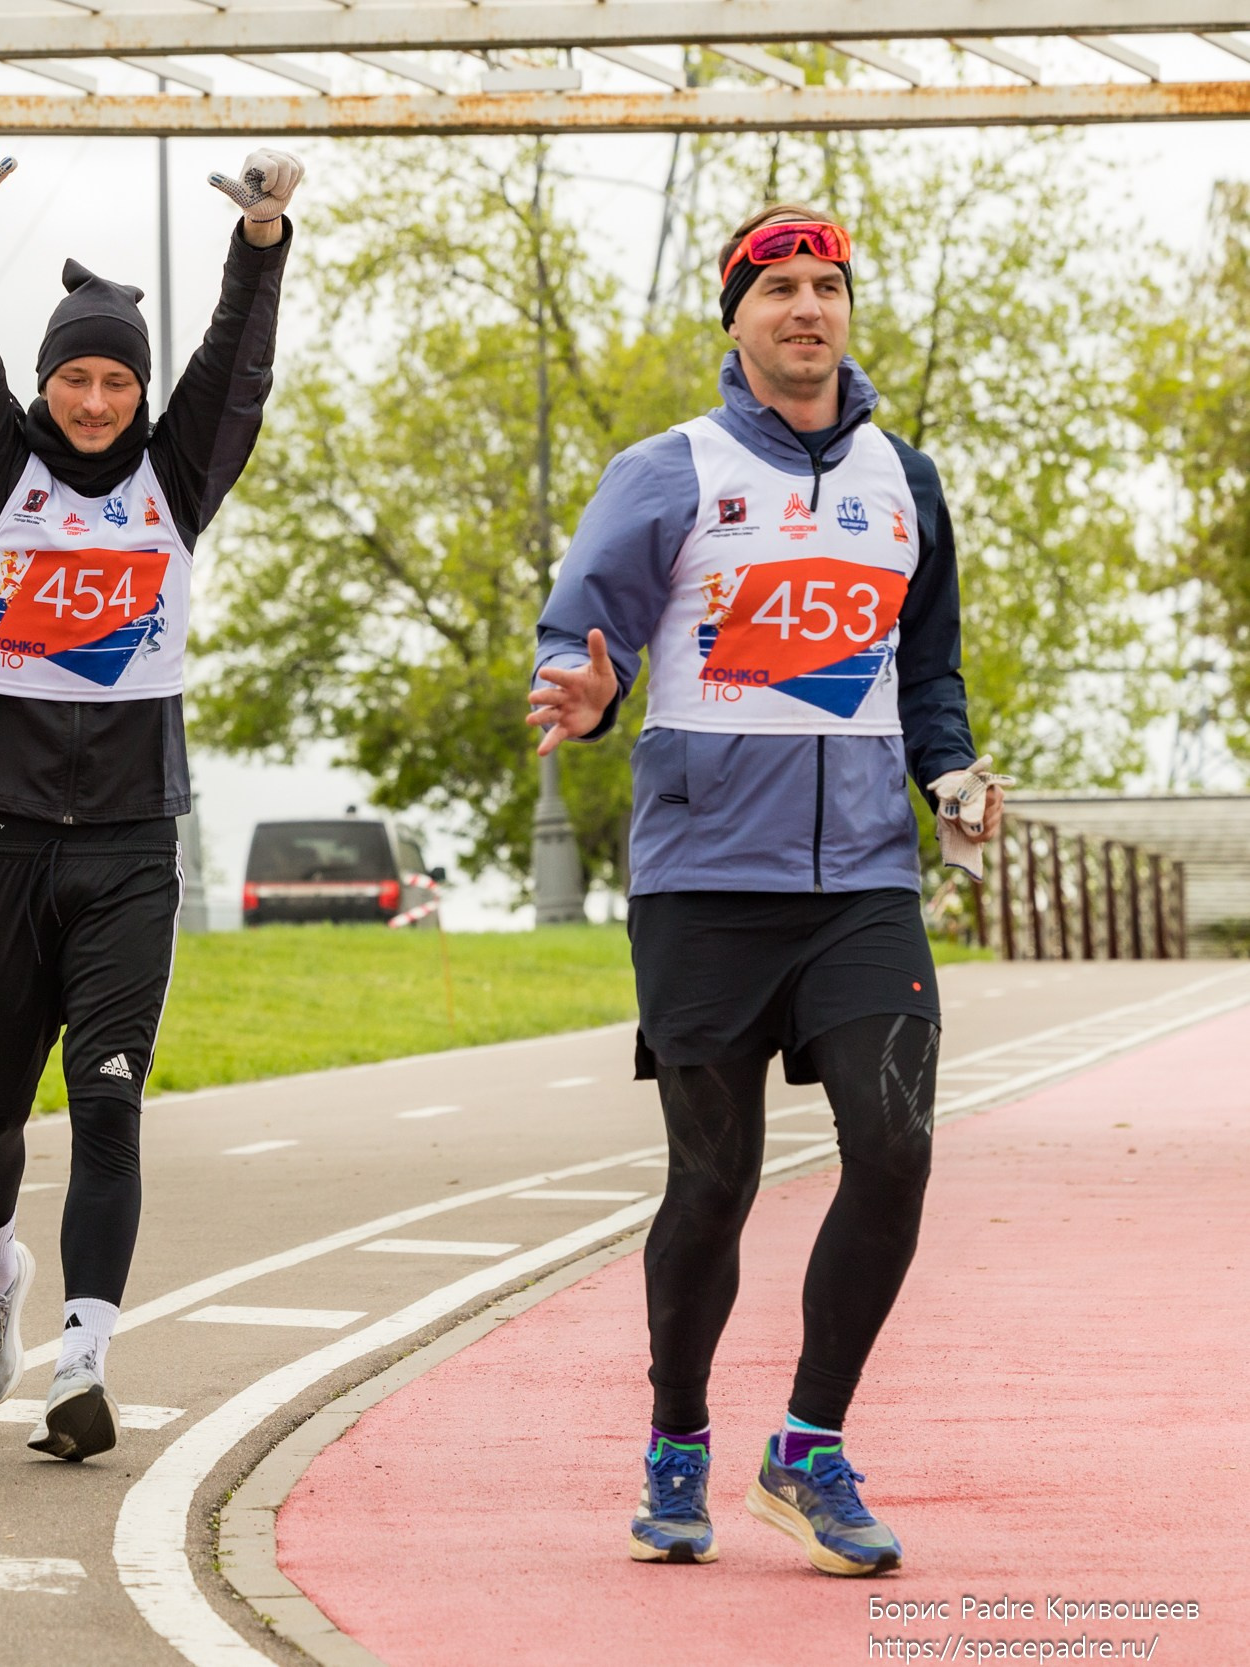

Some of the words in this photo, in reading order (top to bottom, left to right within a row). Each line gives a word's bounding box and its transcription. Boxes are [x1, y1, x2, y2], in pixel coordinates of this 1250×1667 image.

[33, 566, 137, 620] 454
[751, 580, 880, 643] 453
[702, 682, 743, 702] ГТО
[99, 1065, 133, 1080] adidas
